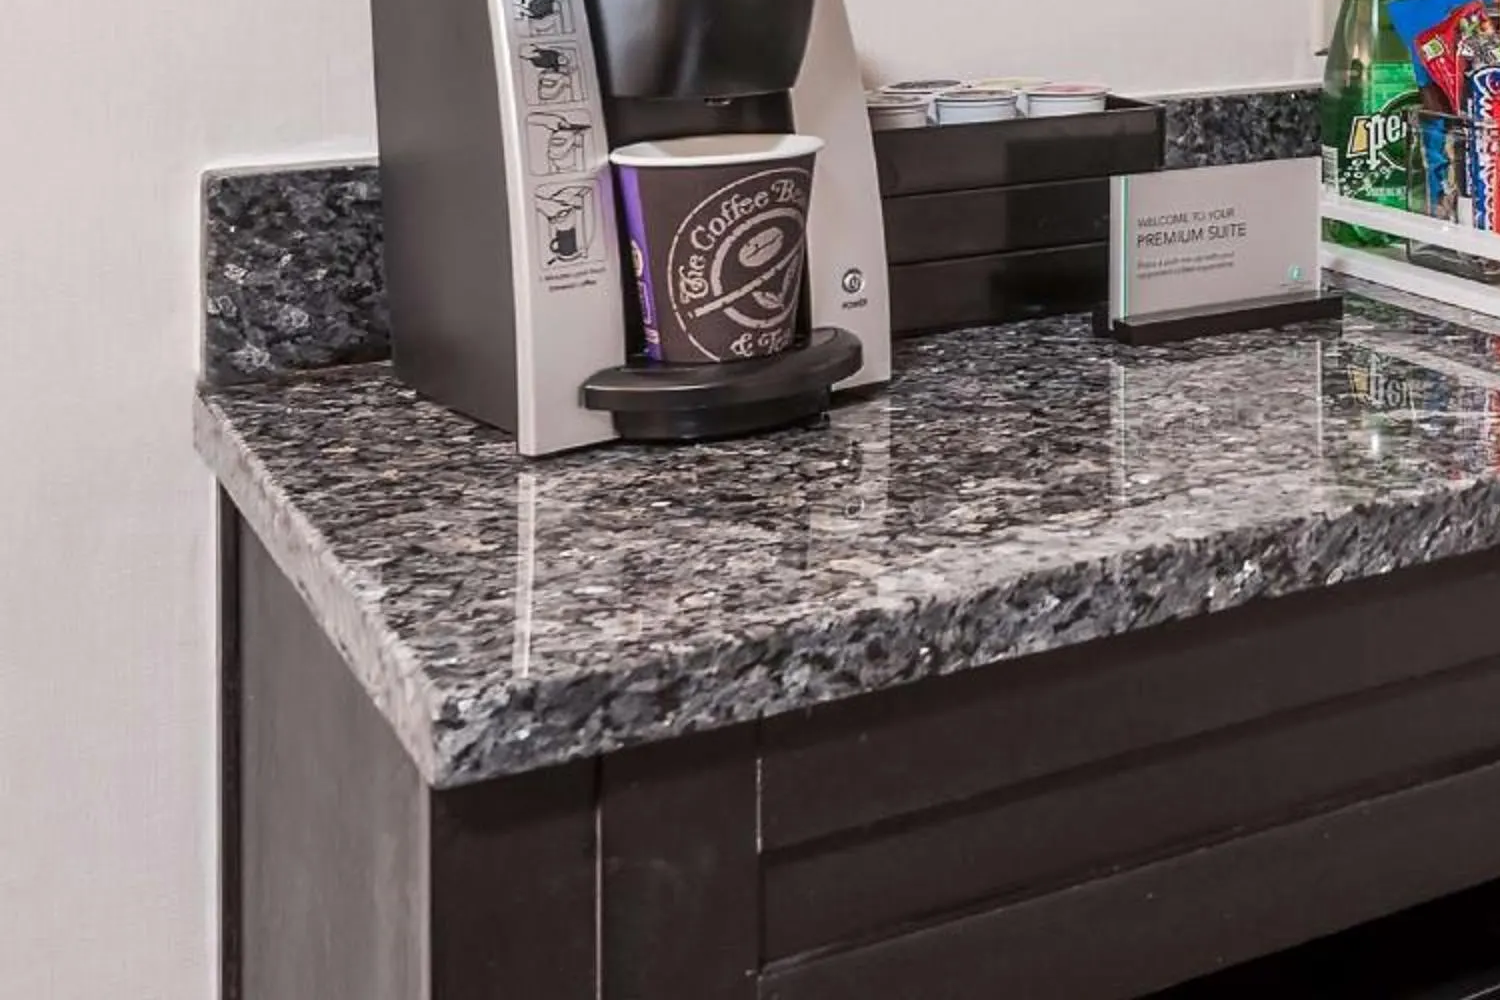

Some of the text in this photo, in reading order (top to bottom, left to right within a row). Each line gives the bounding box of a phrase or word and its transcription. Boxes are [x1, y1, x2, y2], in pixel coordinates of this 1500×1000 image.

[690, 190, 769, 251] Coffee
[1137, 222, 1247, 248] PREMIUM SUITE
[1138, 207, 1235, 227] WELCOME TO YOUR
[678, 254, 709, 304] The
